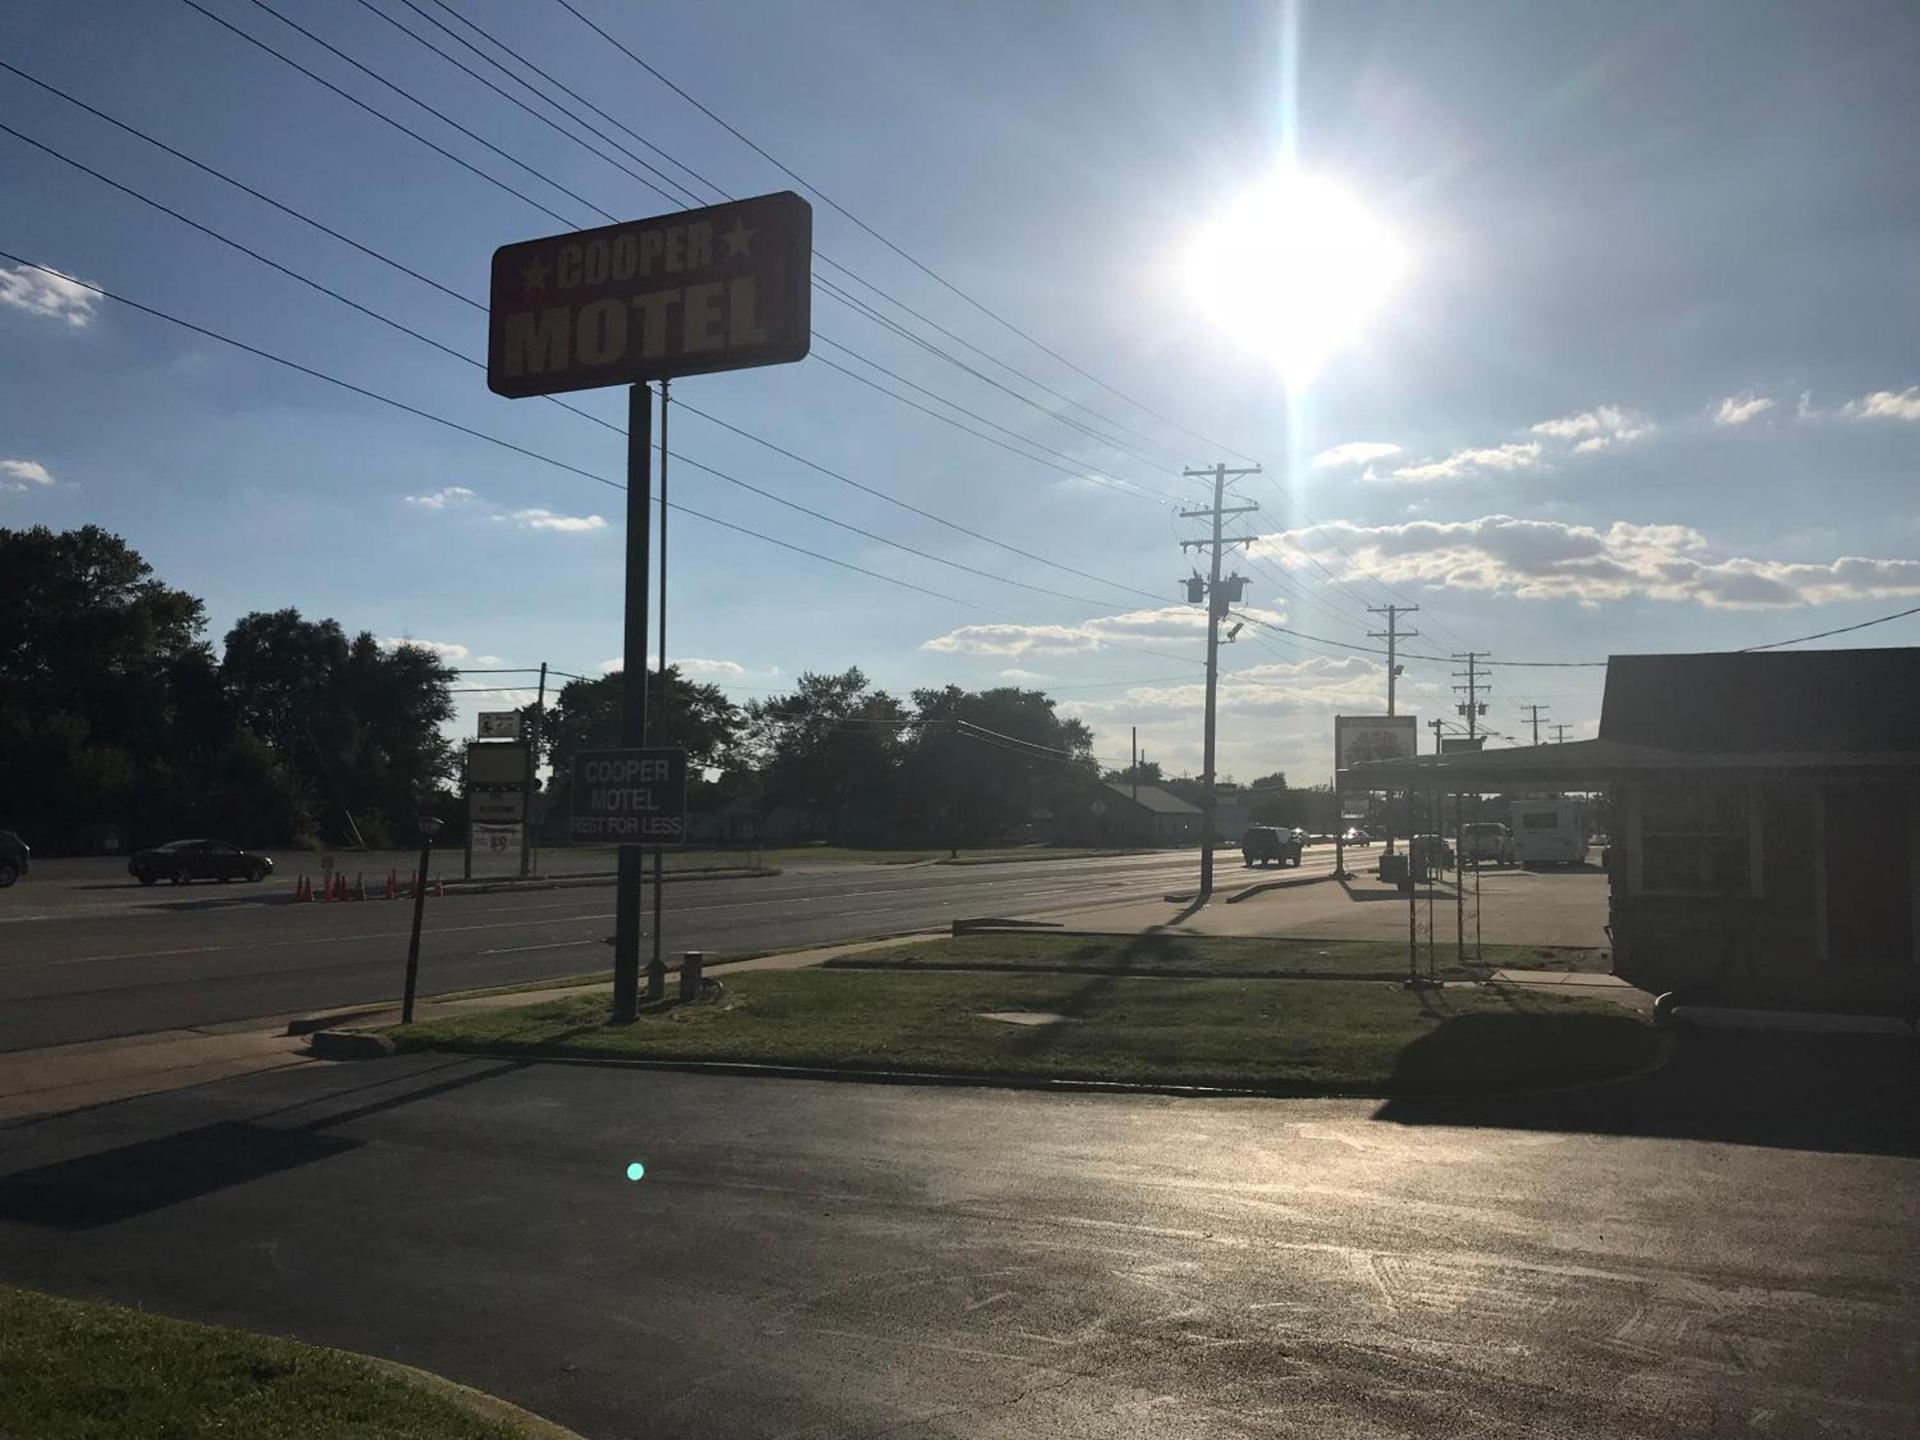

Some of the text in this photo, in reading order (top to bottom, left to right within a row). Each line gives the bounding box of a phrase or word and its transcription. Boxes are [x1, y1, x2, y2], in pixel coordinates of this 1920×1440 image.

[556, 220, 714, 290] COOPER
[504, 276, 769, 377] MOTEL
[584, 759, 670, 783] COOPER
[591, 787, 661, 811] MOTEL
[607, 816, 639, 835] FOR
[641, 816, 683, 835] LESS
